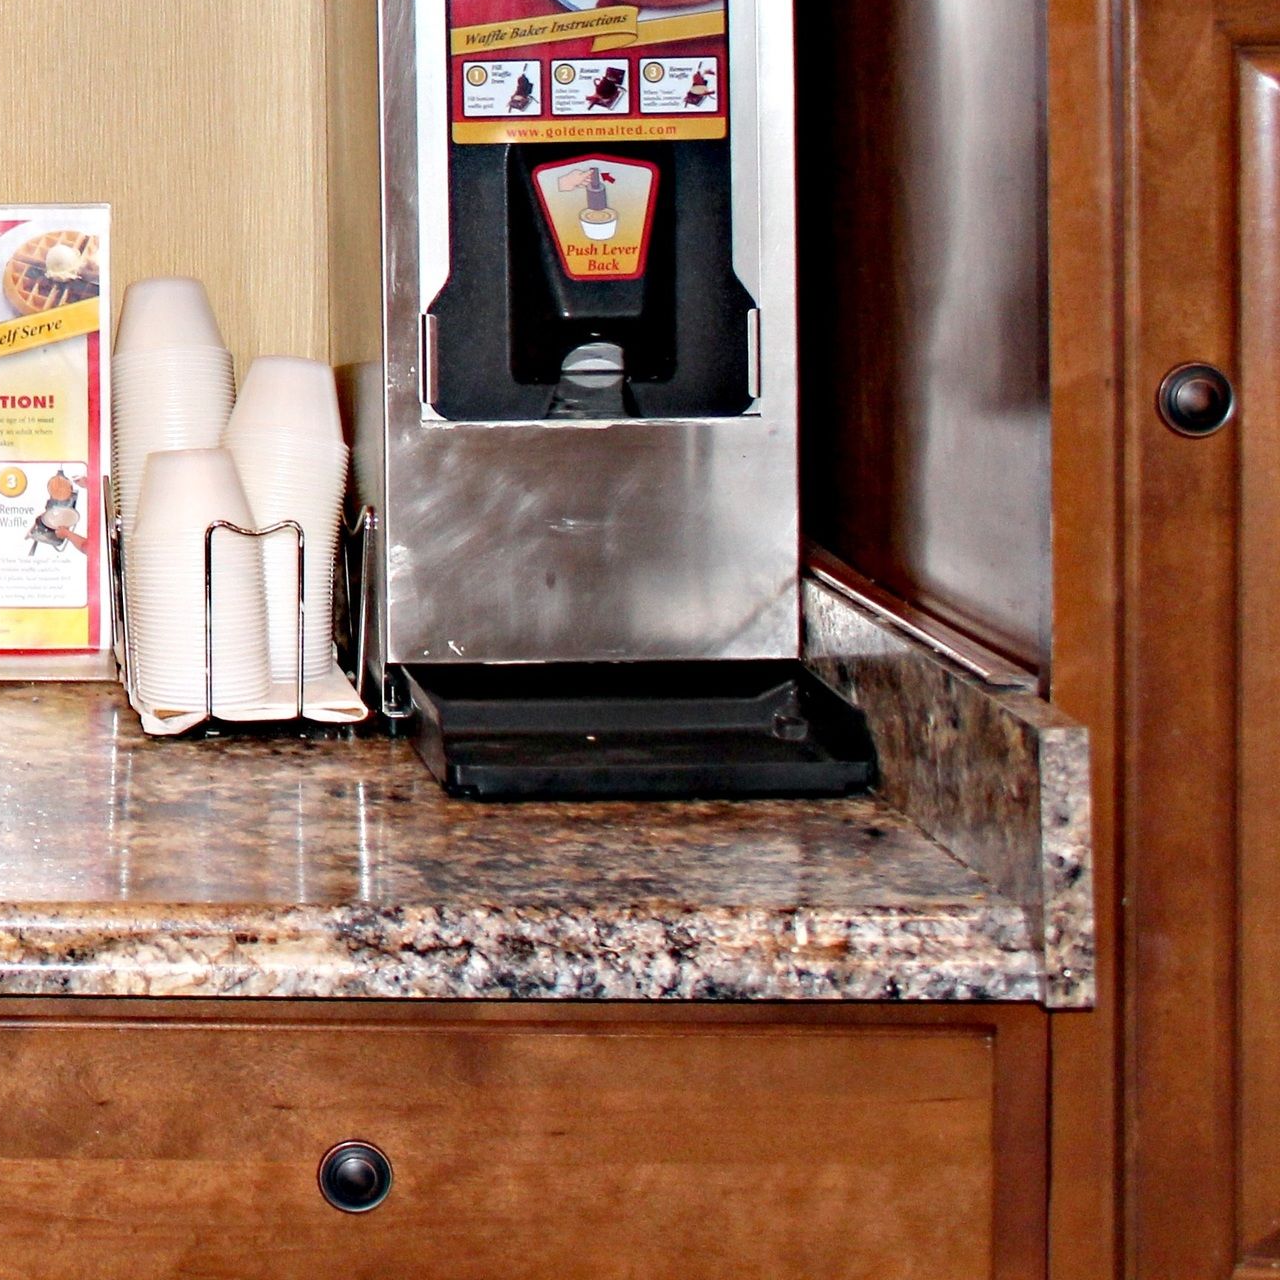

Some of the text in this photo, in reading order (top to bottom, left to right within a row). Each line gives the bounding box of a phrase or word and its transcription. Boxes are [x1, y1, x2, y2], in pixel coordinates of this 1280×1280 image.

[464, 12, 629, 47] Waffle Baker Instructions
[474, 70, 479, 81] 1
[561, 68, 568, 80] 2
[649, 67, 657, 78] 3
[506, 125, 677, 139] www.goldenmalted.com
[567, 243, 638, 257] Push Lever
[588, 258, 620, 271] Back
[21, 319, 63, 339] Serve
[6, 475, 18, 489] 3
[0, 504, 35, 515] Remove
[0, 517, 28, 528] Waffle
